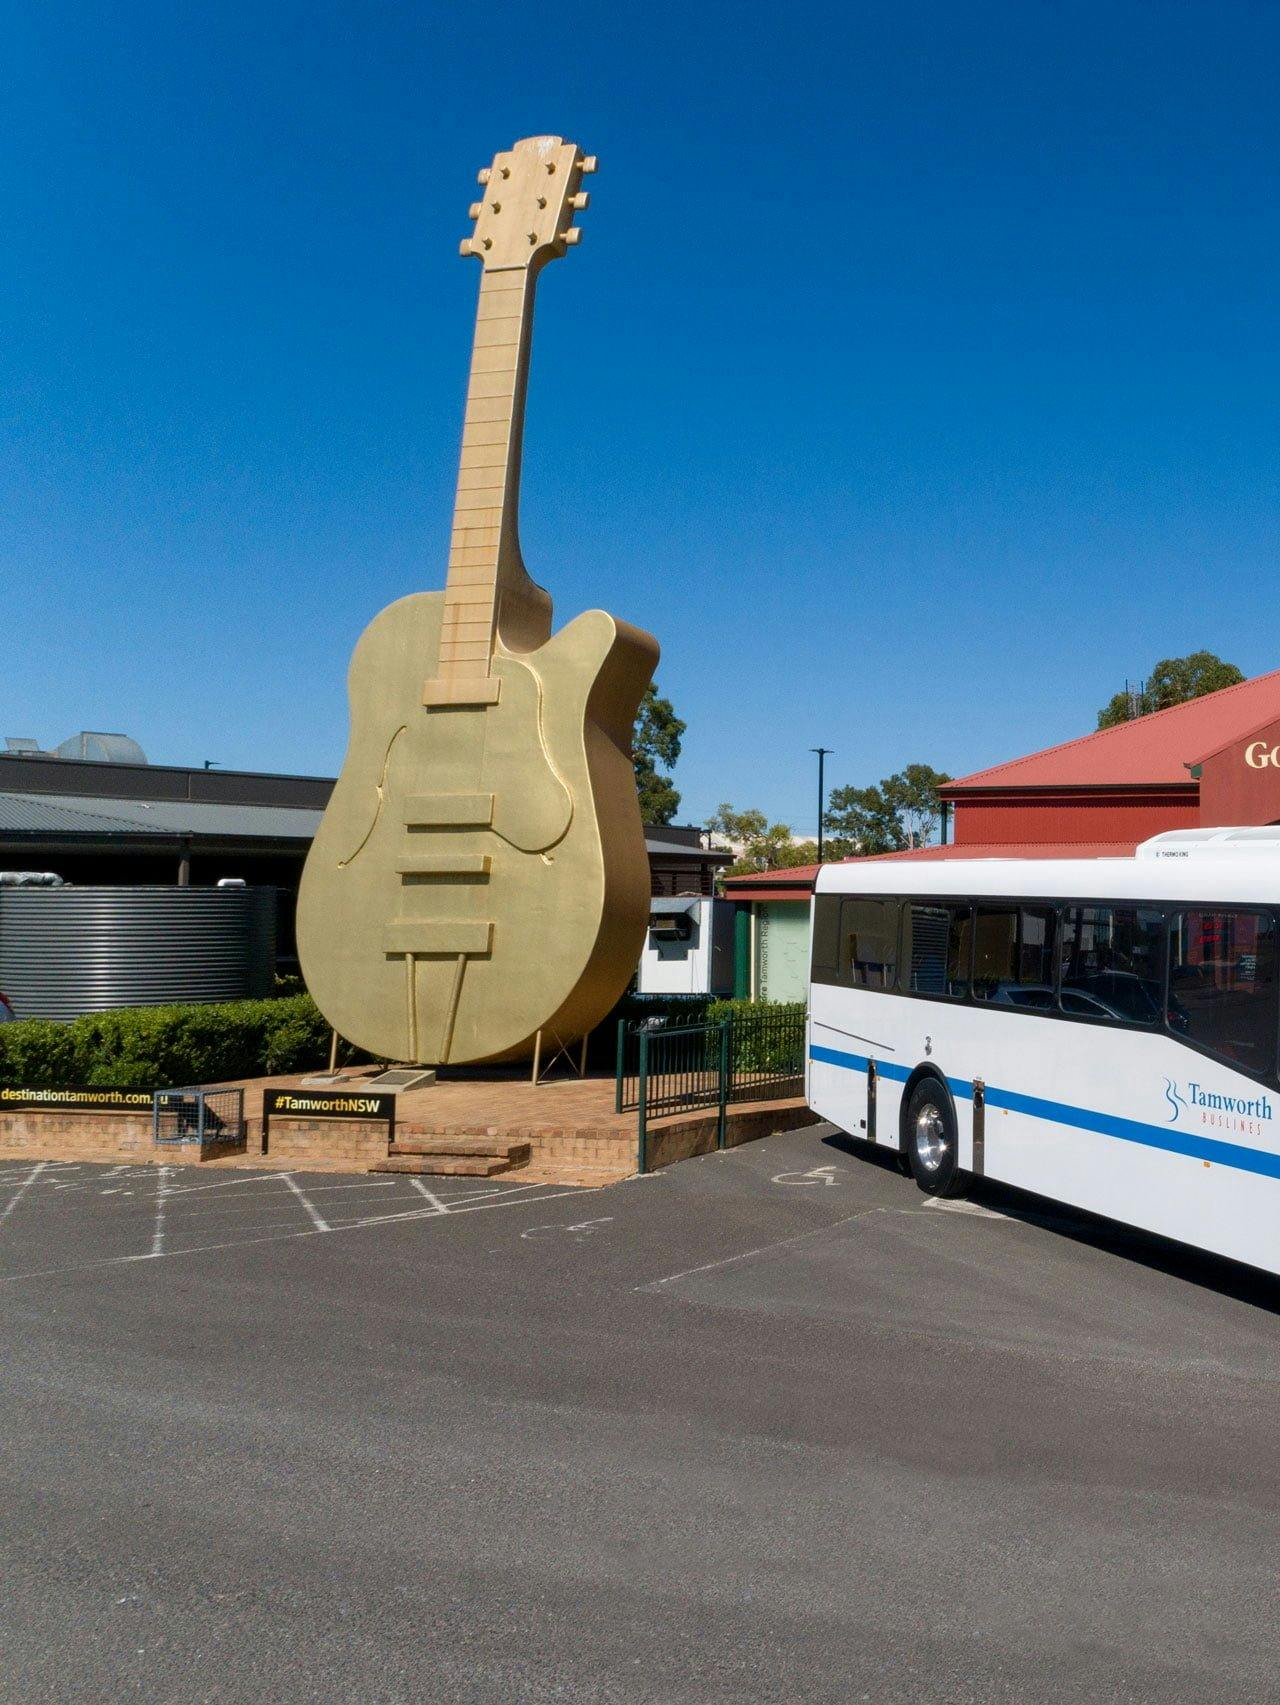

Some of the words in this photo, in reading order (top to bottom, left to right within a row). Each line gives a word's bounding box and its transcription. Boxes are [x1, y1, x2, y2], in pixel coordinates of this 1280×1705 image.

[760, 939, 768, 983] Tamworth
[1, 1088, 168, 1105] destinationtamworth.com.u
[275, 1096, 380, 1112] #TamworthNSW
[1188, 1082, 1272, 1120] Tamworth
[1202, 1112, 1262, 1136] BUSLINES
